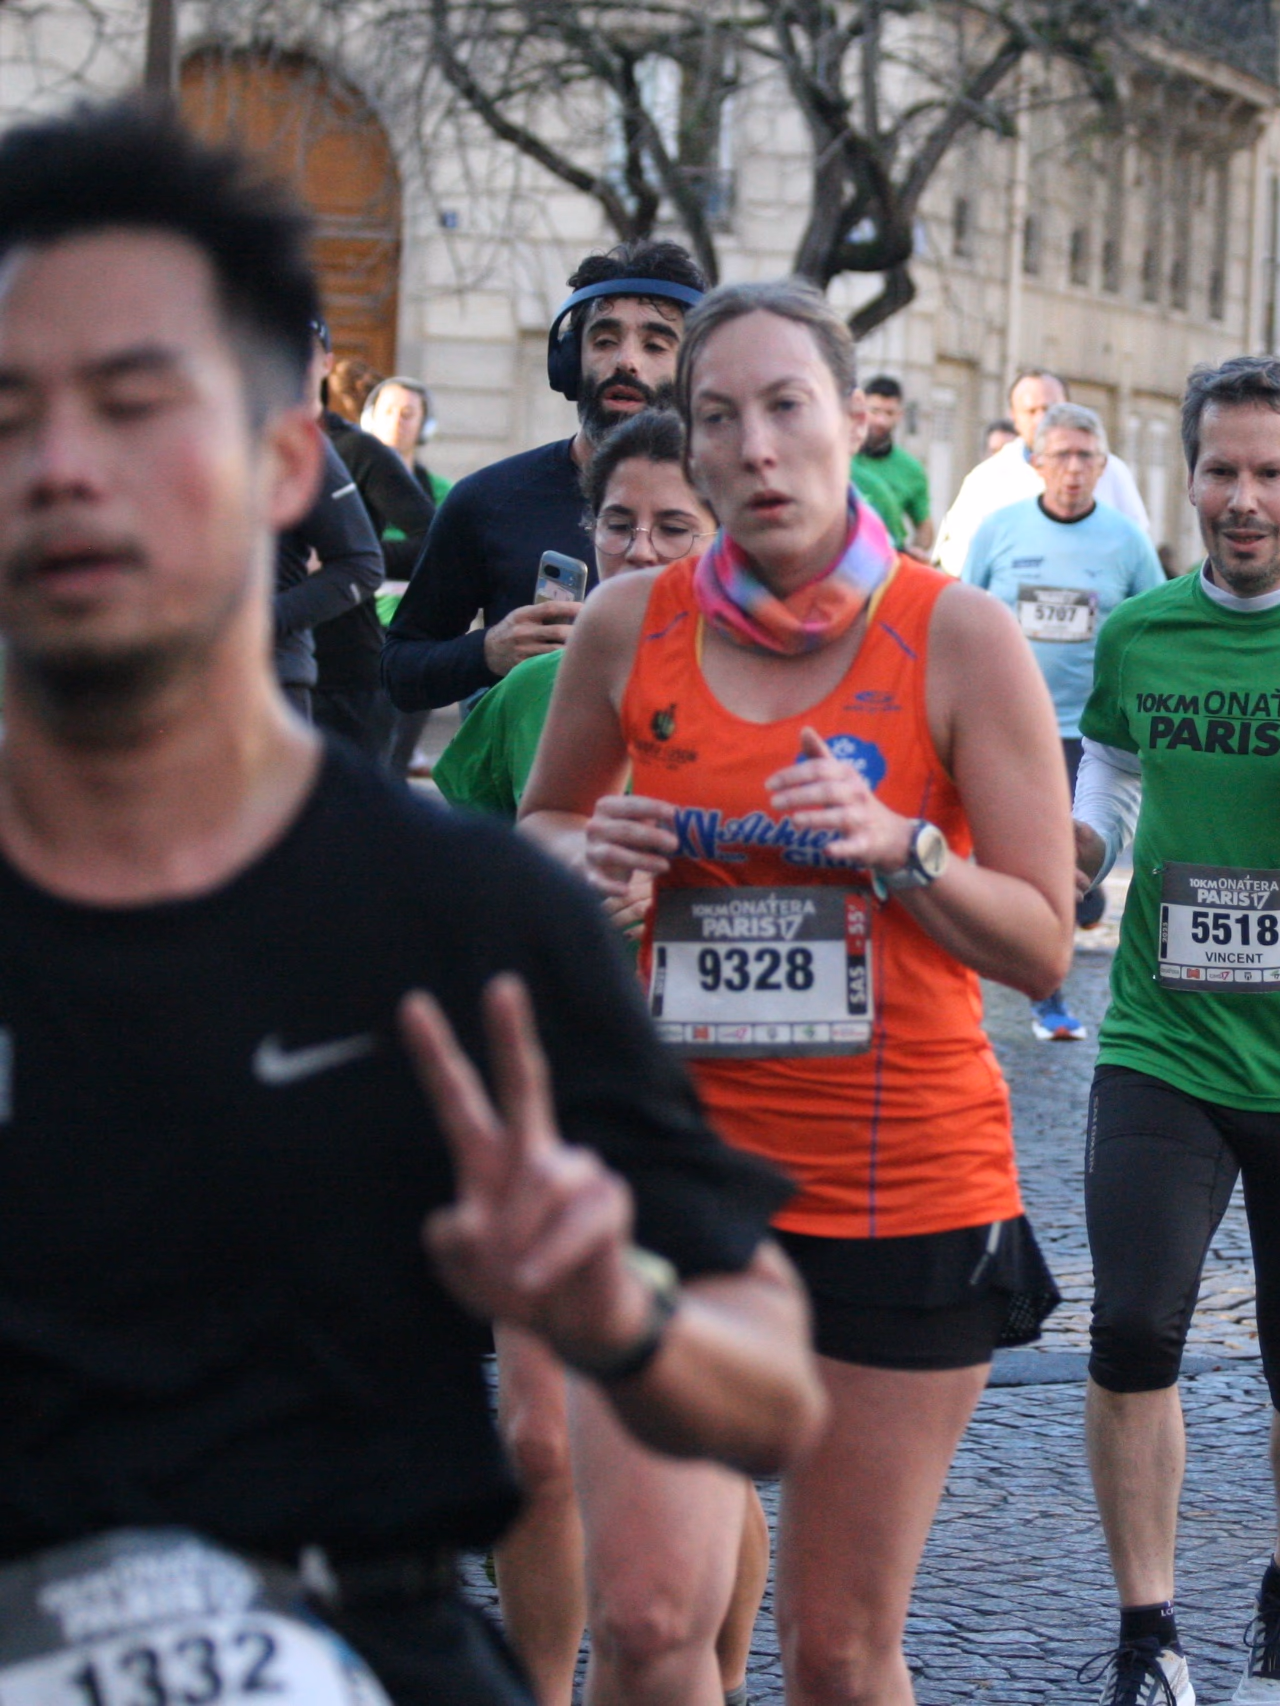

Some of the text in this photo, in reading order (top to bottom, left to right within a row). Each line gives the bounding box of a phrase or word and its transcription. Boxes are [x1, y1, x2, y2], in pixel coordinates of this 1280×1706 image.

[1197, 889, 1271, 909] PARIS 17
[702, 915, 803, 940] PARIS 17
[1191, 910, 1280, 946] 5518
[698, 946, 815, 991] 9328
[1205, 951, 1264, 964] VINCENT
[850, 966, 866, 1003] SAS
[71, 1630, 286, 1706] 1332
